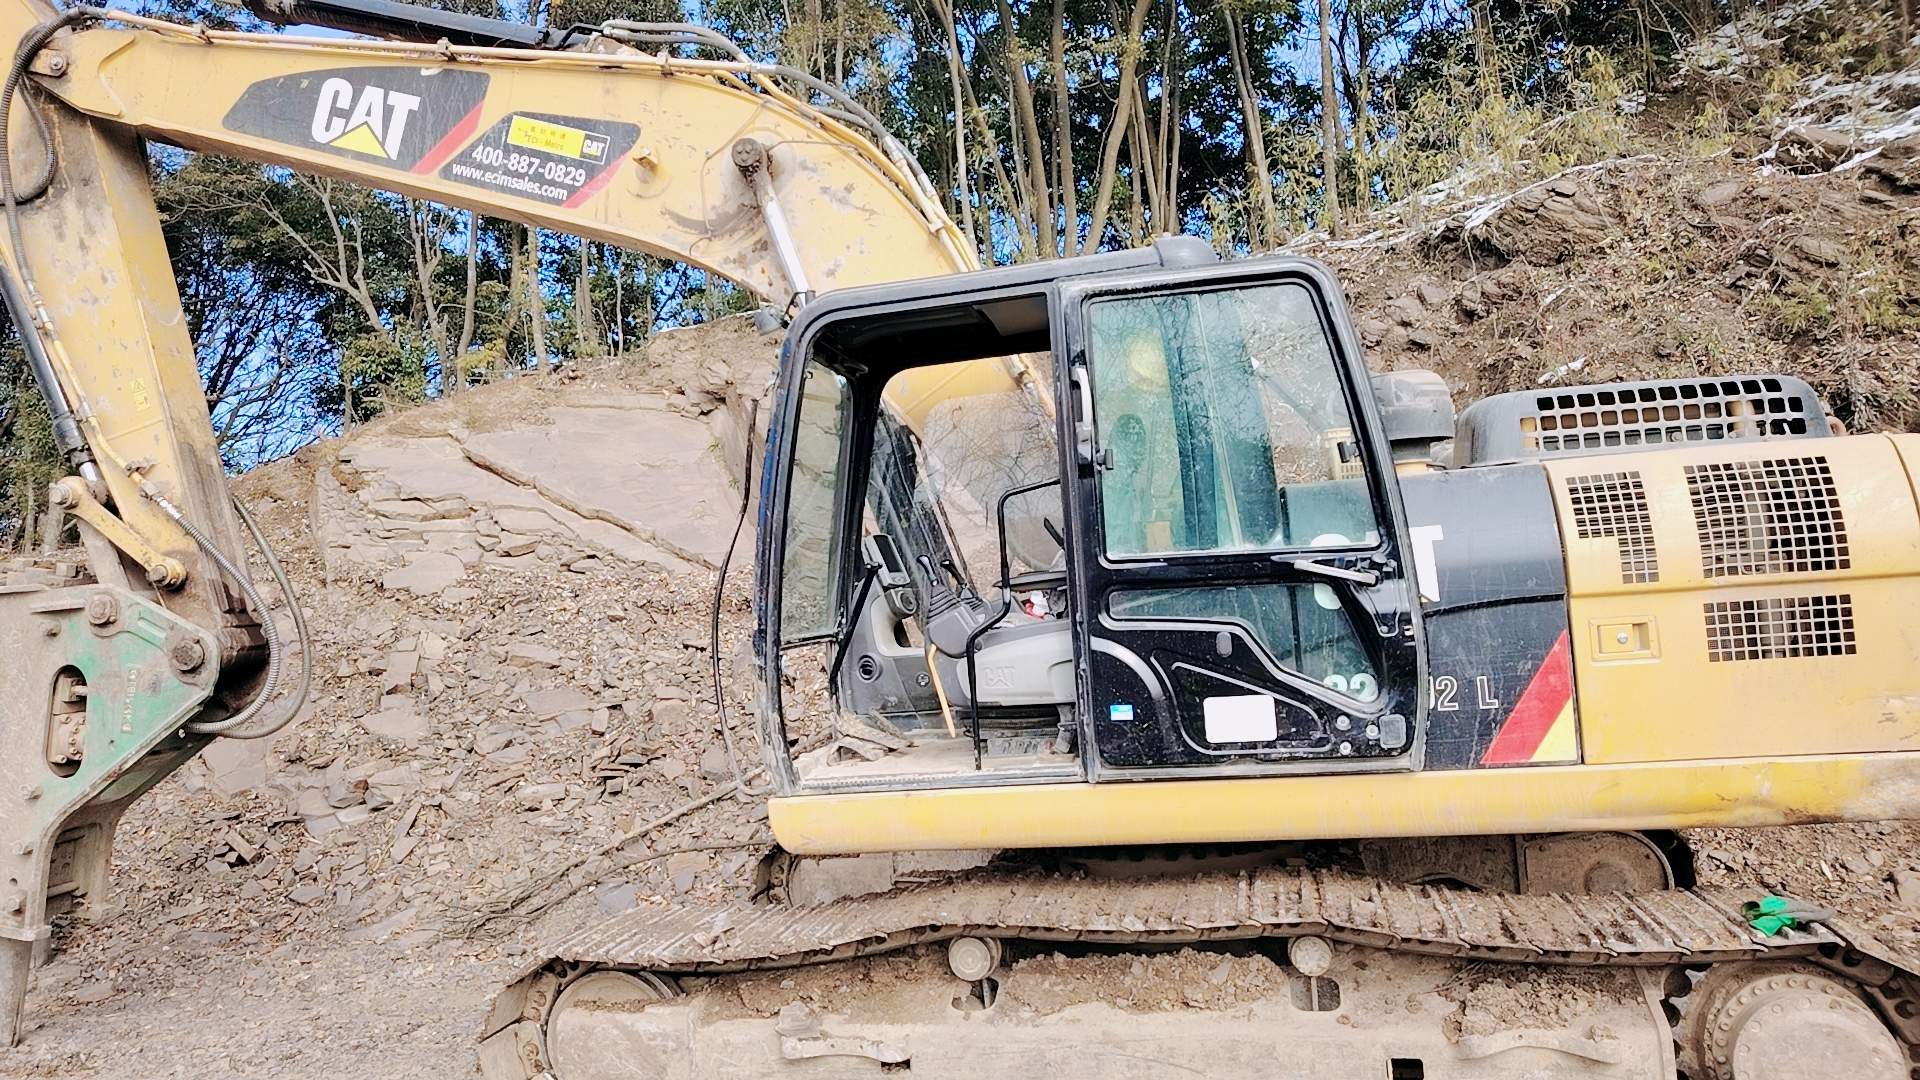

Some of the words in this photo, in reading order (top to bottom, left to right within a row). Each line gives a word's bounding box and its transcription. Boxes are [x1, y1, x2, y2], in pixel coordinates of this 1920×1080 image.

[311, 77, 421, 161] CAT
[472, 141, 586, 187] 400-887-0829
[582, 139, 605, 157] CAT
[452, 163, 568, 200] www.ecimsales.com
